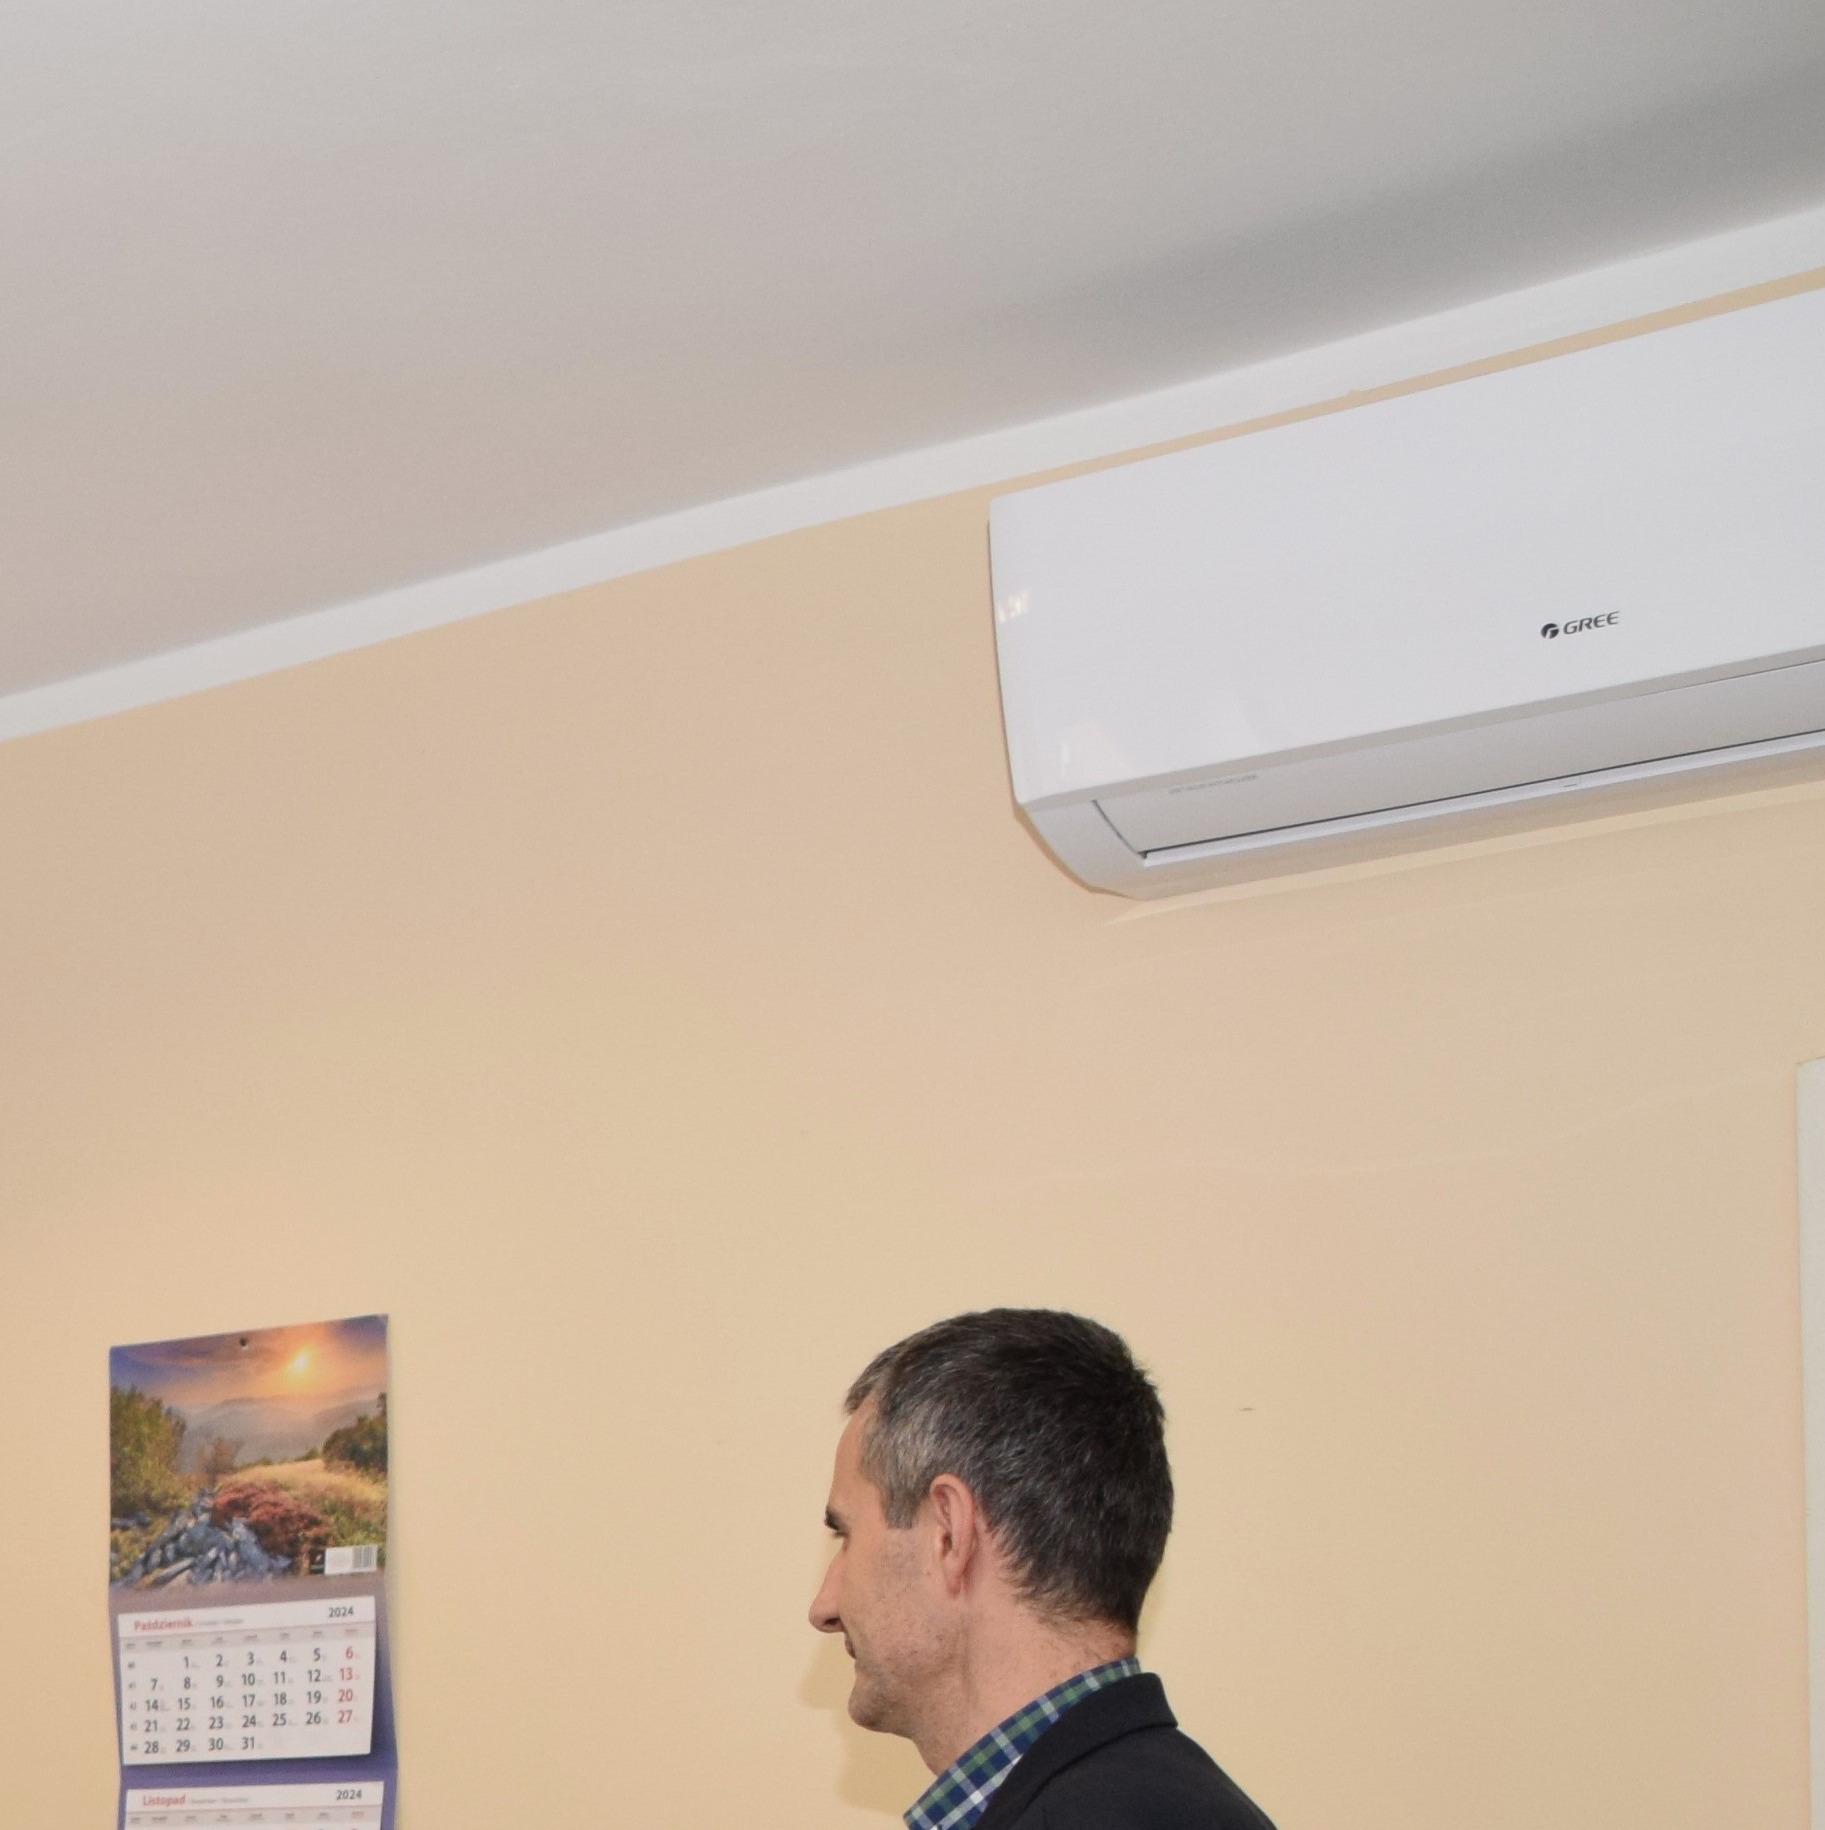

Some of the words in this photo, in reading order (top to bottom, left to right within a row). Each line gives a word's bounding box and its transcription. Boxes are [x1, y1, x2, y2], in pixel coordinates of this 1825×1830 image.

[1563, 610, 1620, 635] GREE
[135, 1617, 192, 1630] Październik
[329, 1607, 354, 1617] 2024
[184, 1657, 189, 1668] 1
[216, 1655, 223, 1666] 2
[248, 1653, 254, 1665] 3
[280, 1651, 287, 1662] 4
[314, 1649, 321, 1661] 5
[346, 1647, 353, 1659] 6
[151, 1679, 157, 1691] 7
[184, 1677, 191, 1689] 8
[216, 1676, 223, 1687] 9
[242, 1674, 255, 1685] 10
[274, 1672, 286, 1684] 11
[308, 1670, 321, 1682] 12
[340, 1668, 352, 1680] 13
[146, 1700, 158, 1711] 14
[178, 1698, 190, 1710] 15
[211, 1697, 223, 1708] 16
[243, 1695, 255, 1707] 17
[274, 1694, 286, 1705] 18
[307, 1692, 321, 1703] 19
[339, 1690, 353, 1701] 20
[145, 1720, 157, 1732] 21
[176, 1719, 190, 1730] 22
[209, 1717, 223, 1729] 23
[242, 1716, 256, 1728] 24
[273, 1714, 286, 1726] 25
[306, 1712, 321, 1724] 26
[338, 1711, 352, 1723] 27
[145, 1742, 159, 1754] 28
[176, 1740, 190, 1752] 29
[209, 1738, 223, 1750] 30
[243, 1737, 255, 1749] 31
[143, 1795, 185, 1807] Listopad
[337, 1790, 361, 1800] 2024
